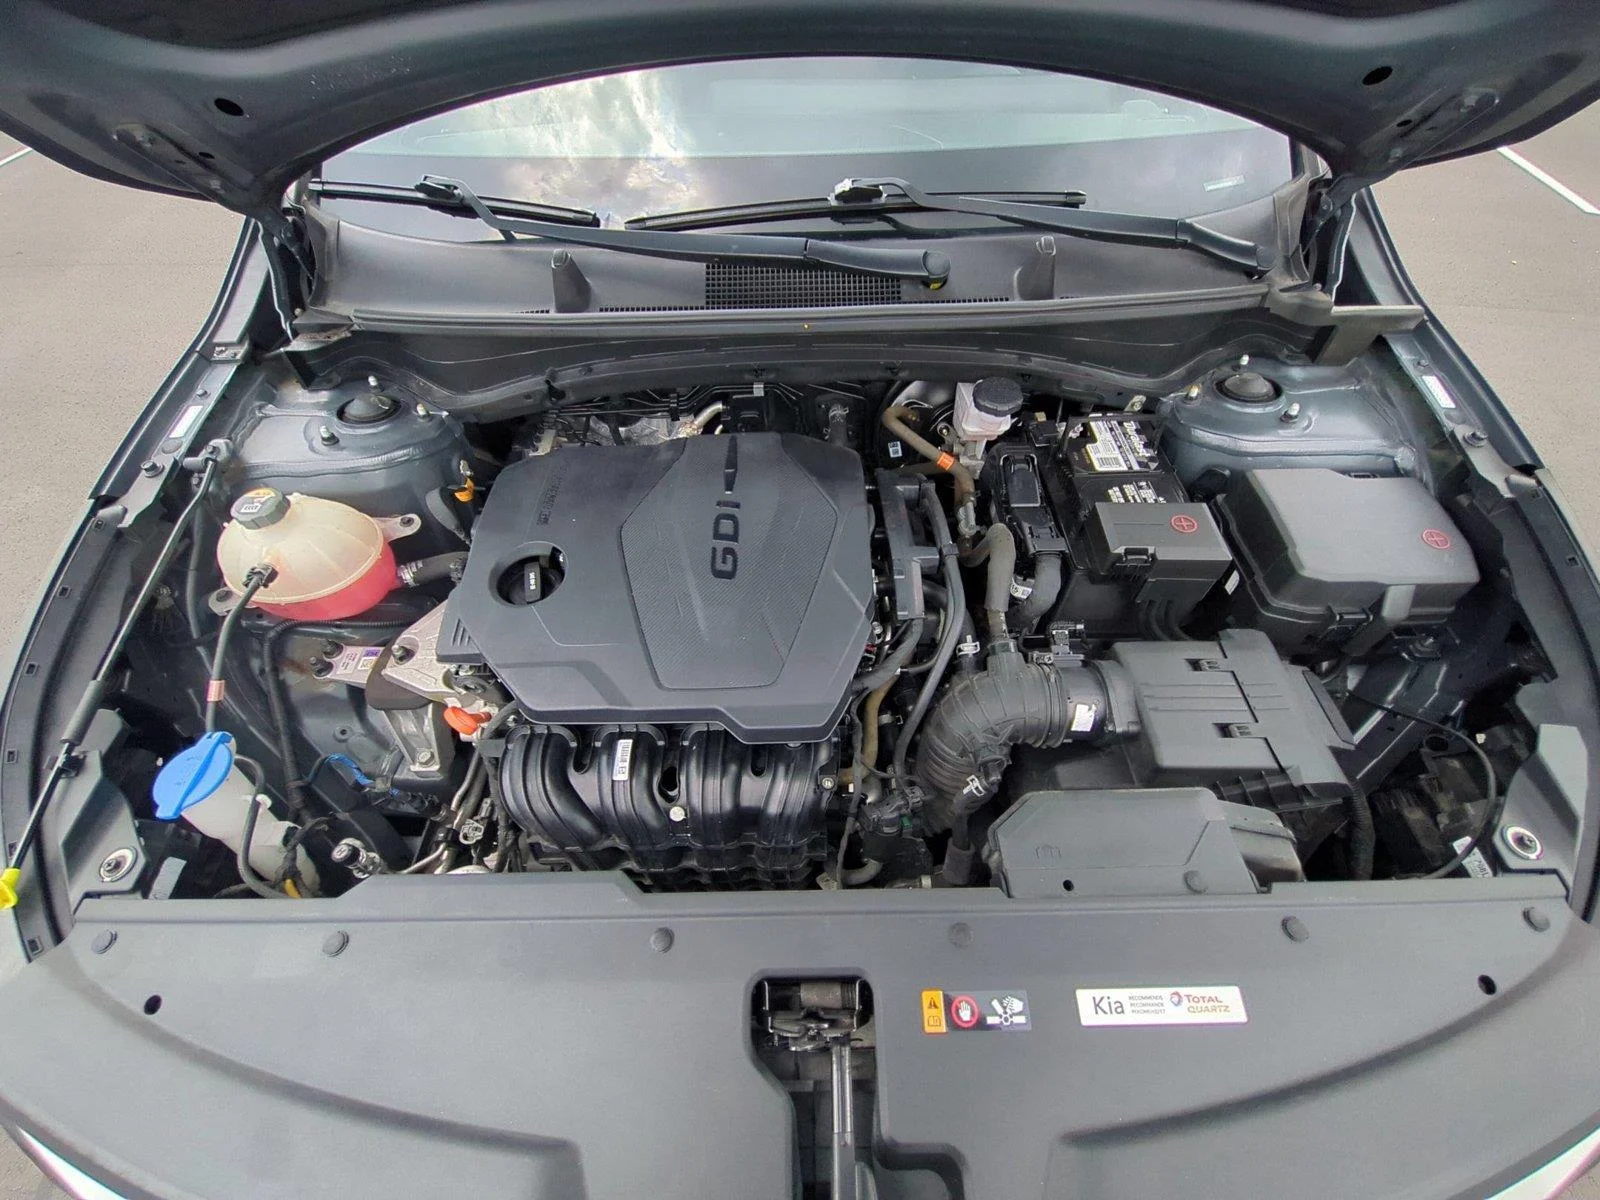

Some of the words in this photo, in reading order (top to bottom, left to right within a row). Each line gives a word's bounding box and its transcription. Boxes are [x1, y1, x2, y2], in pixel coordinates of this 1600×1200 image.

[710, 501, 741, 580] GDI
[1092, 995, 1125, 1015] Kia
[1184, 994, 1223, 1004] TOTAL
[1187, 1004, 1231, 1014] QUARTZ
